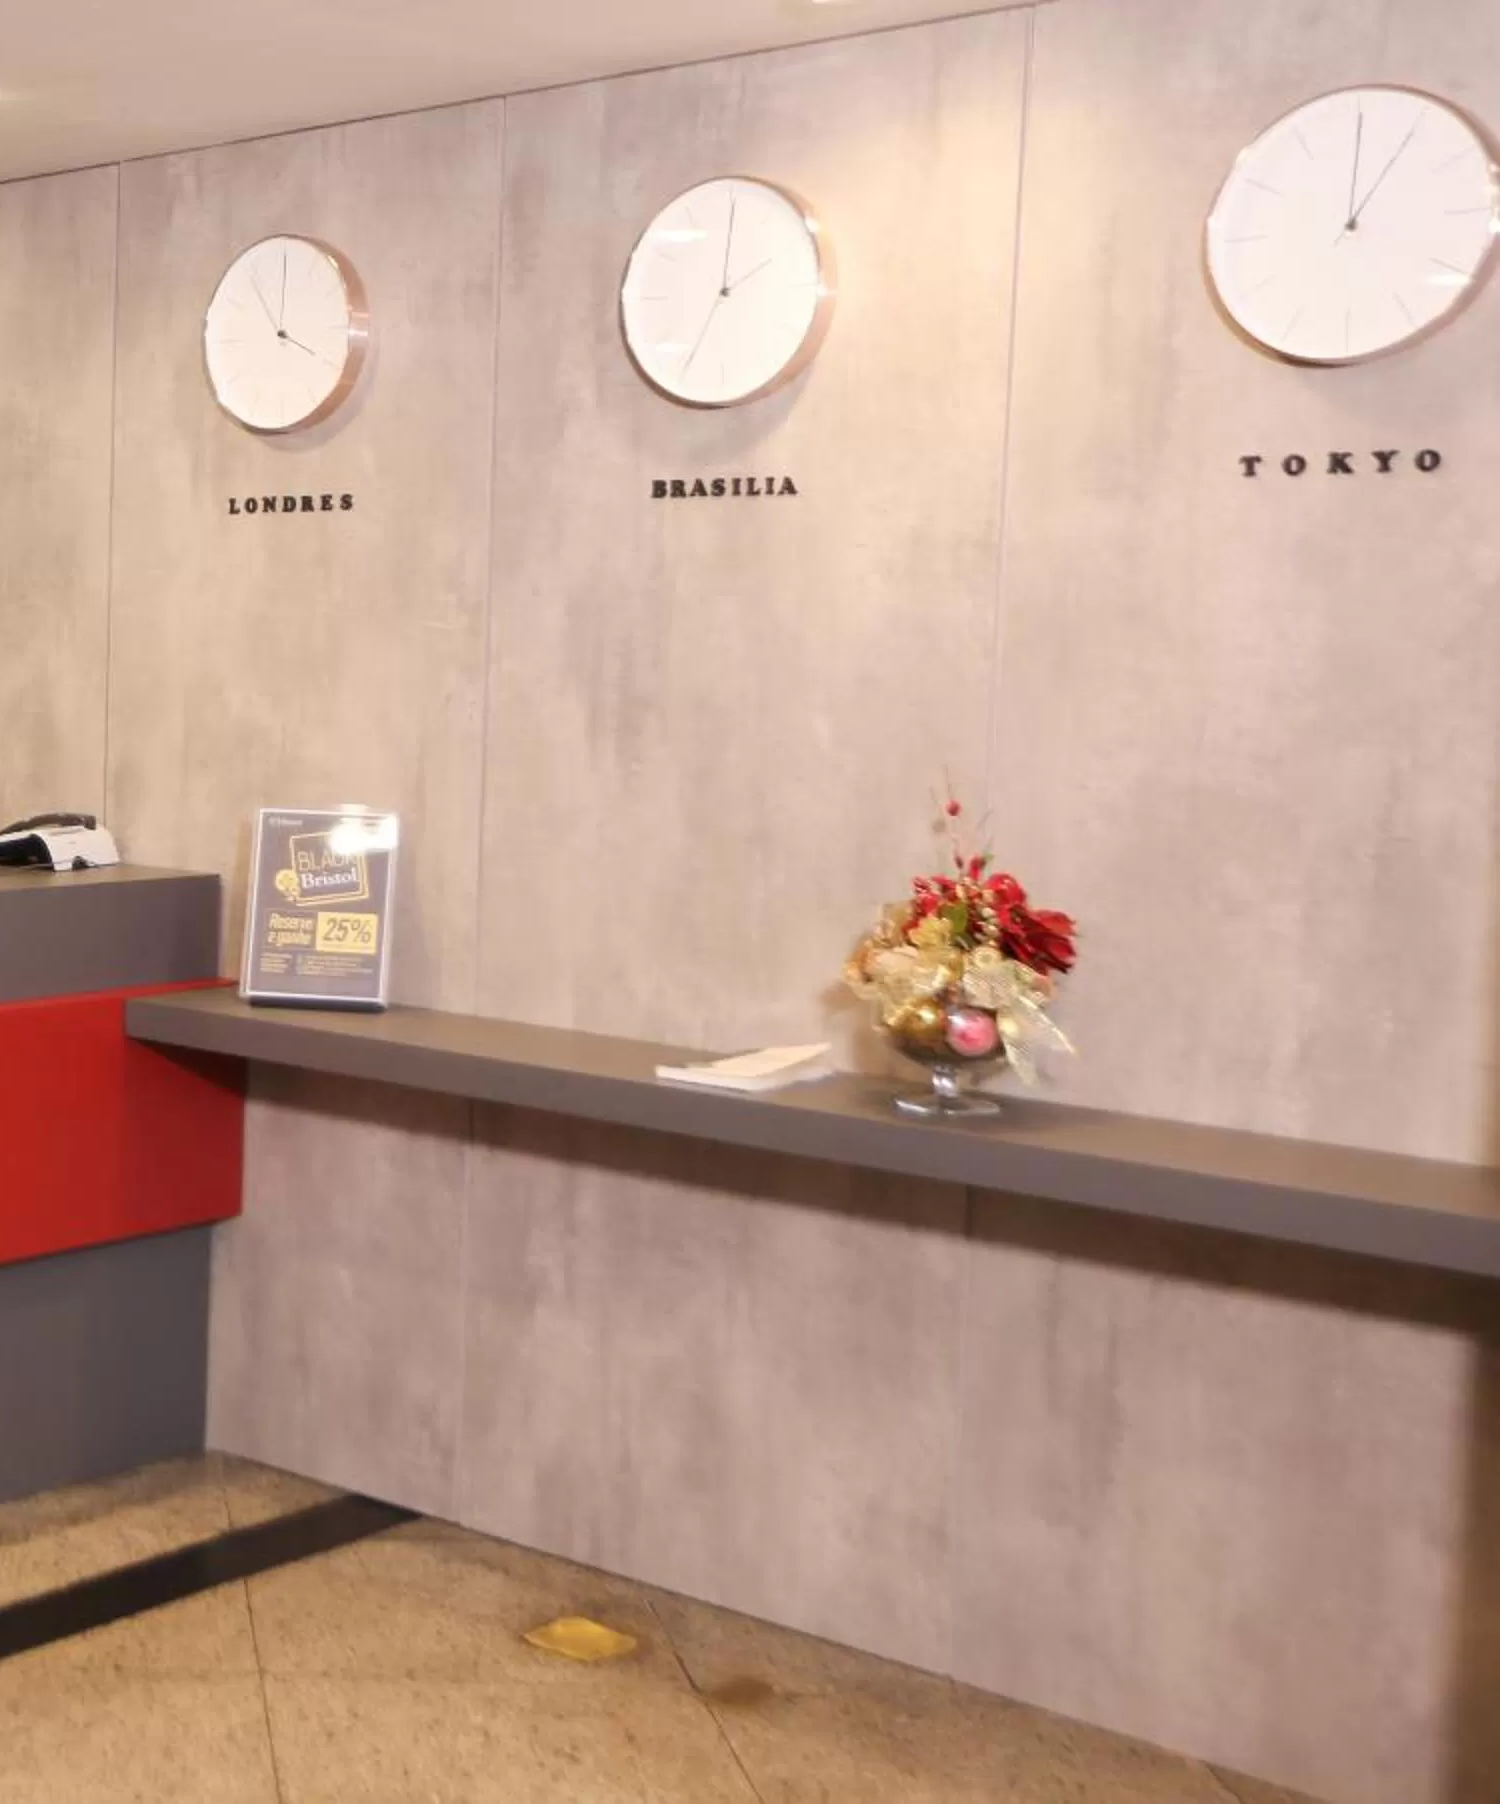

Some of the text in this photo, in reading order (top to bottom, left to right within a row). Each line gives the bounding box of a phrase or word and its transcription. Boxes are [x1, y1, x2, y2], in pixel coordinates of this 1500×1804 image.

[1238, 449, 1442, 478] TOKYO
[651, 476, 799, 499] BRASILIA
[228, 494, 354, 515] LONDRES
[300, 867, 358, 889] Bristol
[323, 917, 373, 944] 25%
